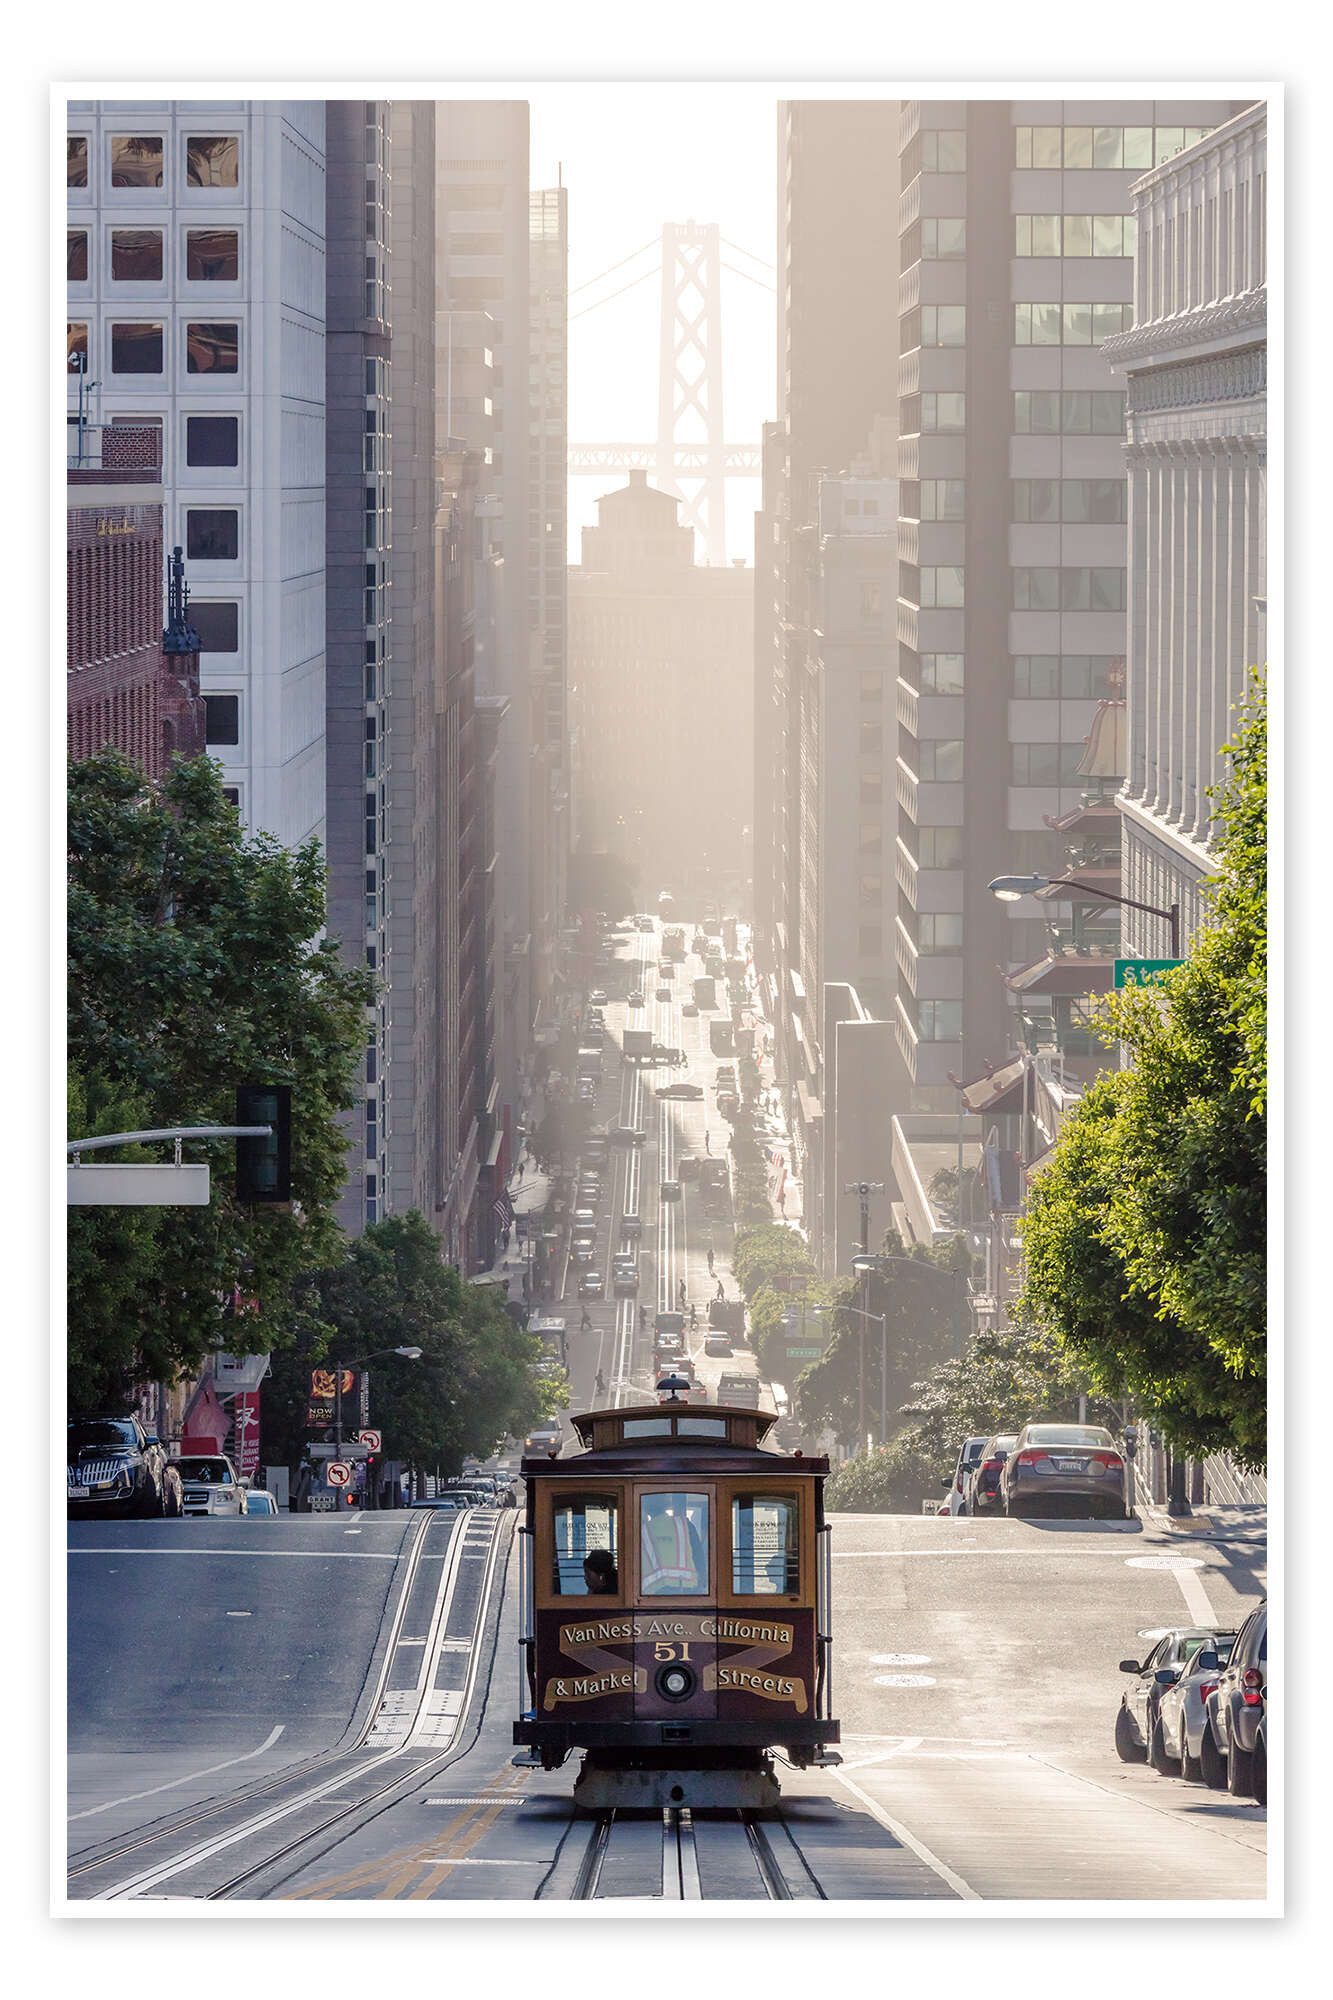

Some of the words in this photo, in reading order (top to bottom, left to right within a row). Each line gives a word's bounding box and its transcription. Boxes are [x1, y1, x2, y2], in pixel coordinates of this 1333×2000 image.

[565, 1626, 597, 1643] Van
[598, 1623, 642, 1640] Ness
[699, 1619, 790, 1642] California
[653, 1641, 694, 1662] 51
[556, 1680, 569, 1696] &
[573, 1671, 639, 1696] Market
[718, 1669, 794, 1694] Streets
